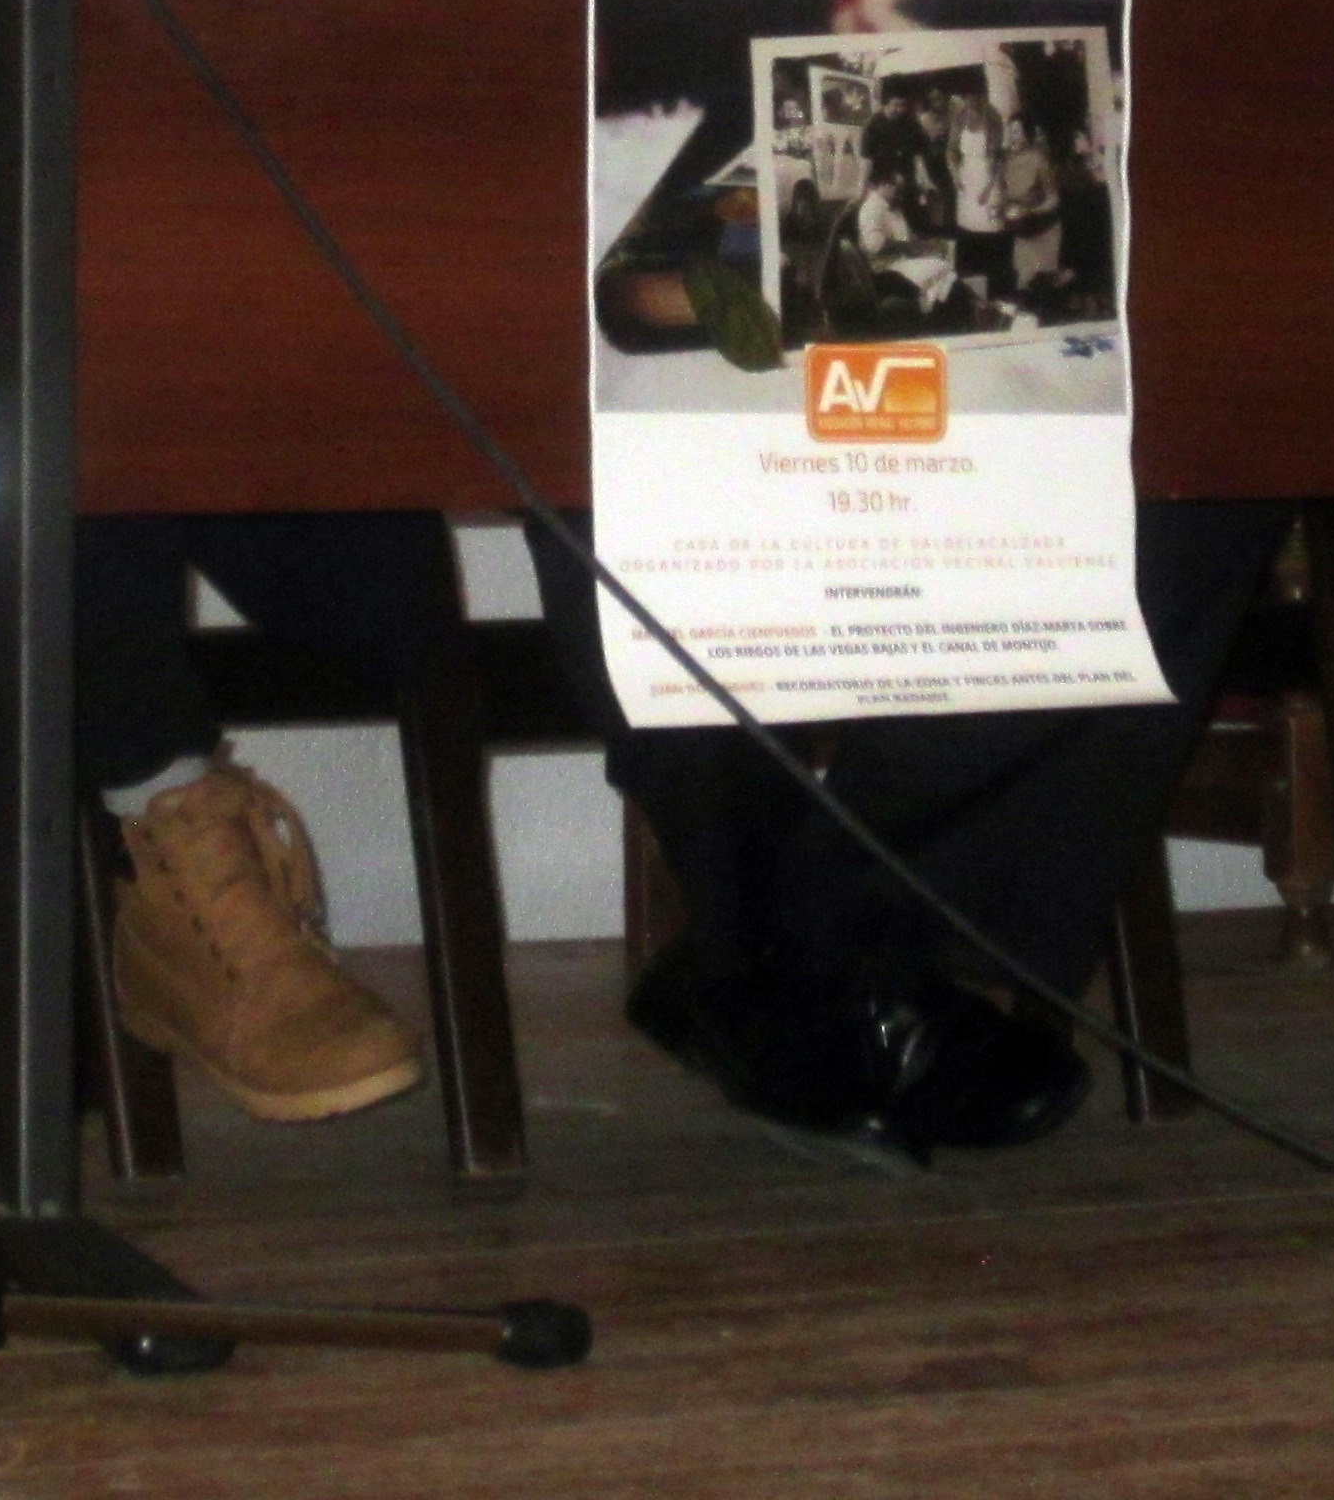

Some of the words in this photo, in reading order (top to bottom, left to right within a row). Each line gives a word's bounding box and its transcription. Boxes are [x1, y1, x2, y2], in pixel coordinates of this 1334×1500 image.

[759, 451, 840, 474] Viernes
[845, 450, 869, 474] 10
[874, 452, 900, 474] de
[827, 489, 884, 514] 19.30
